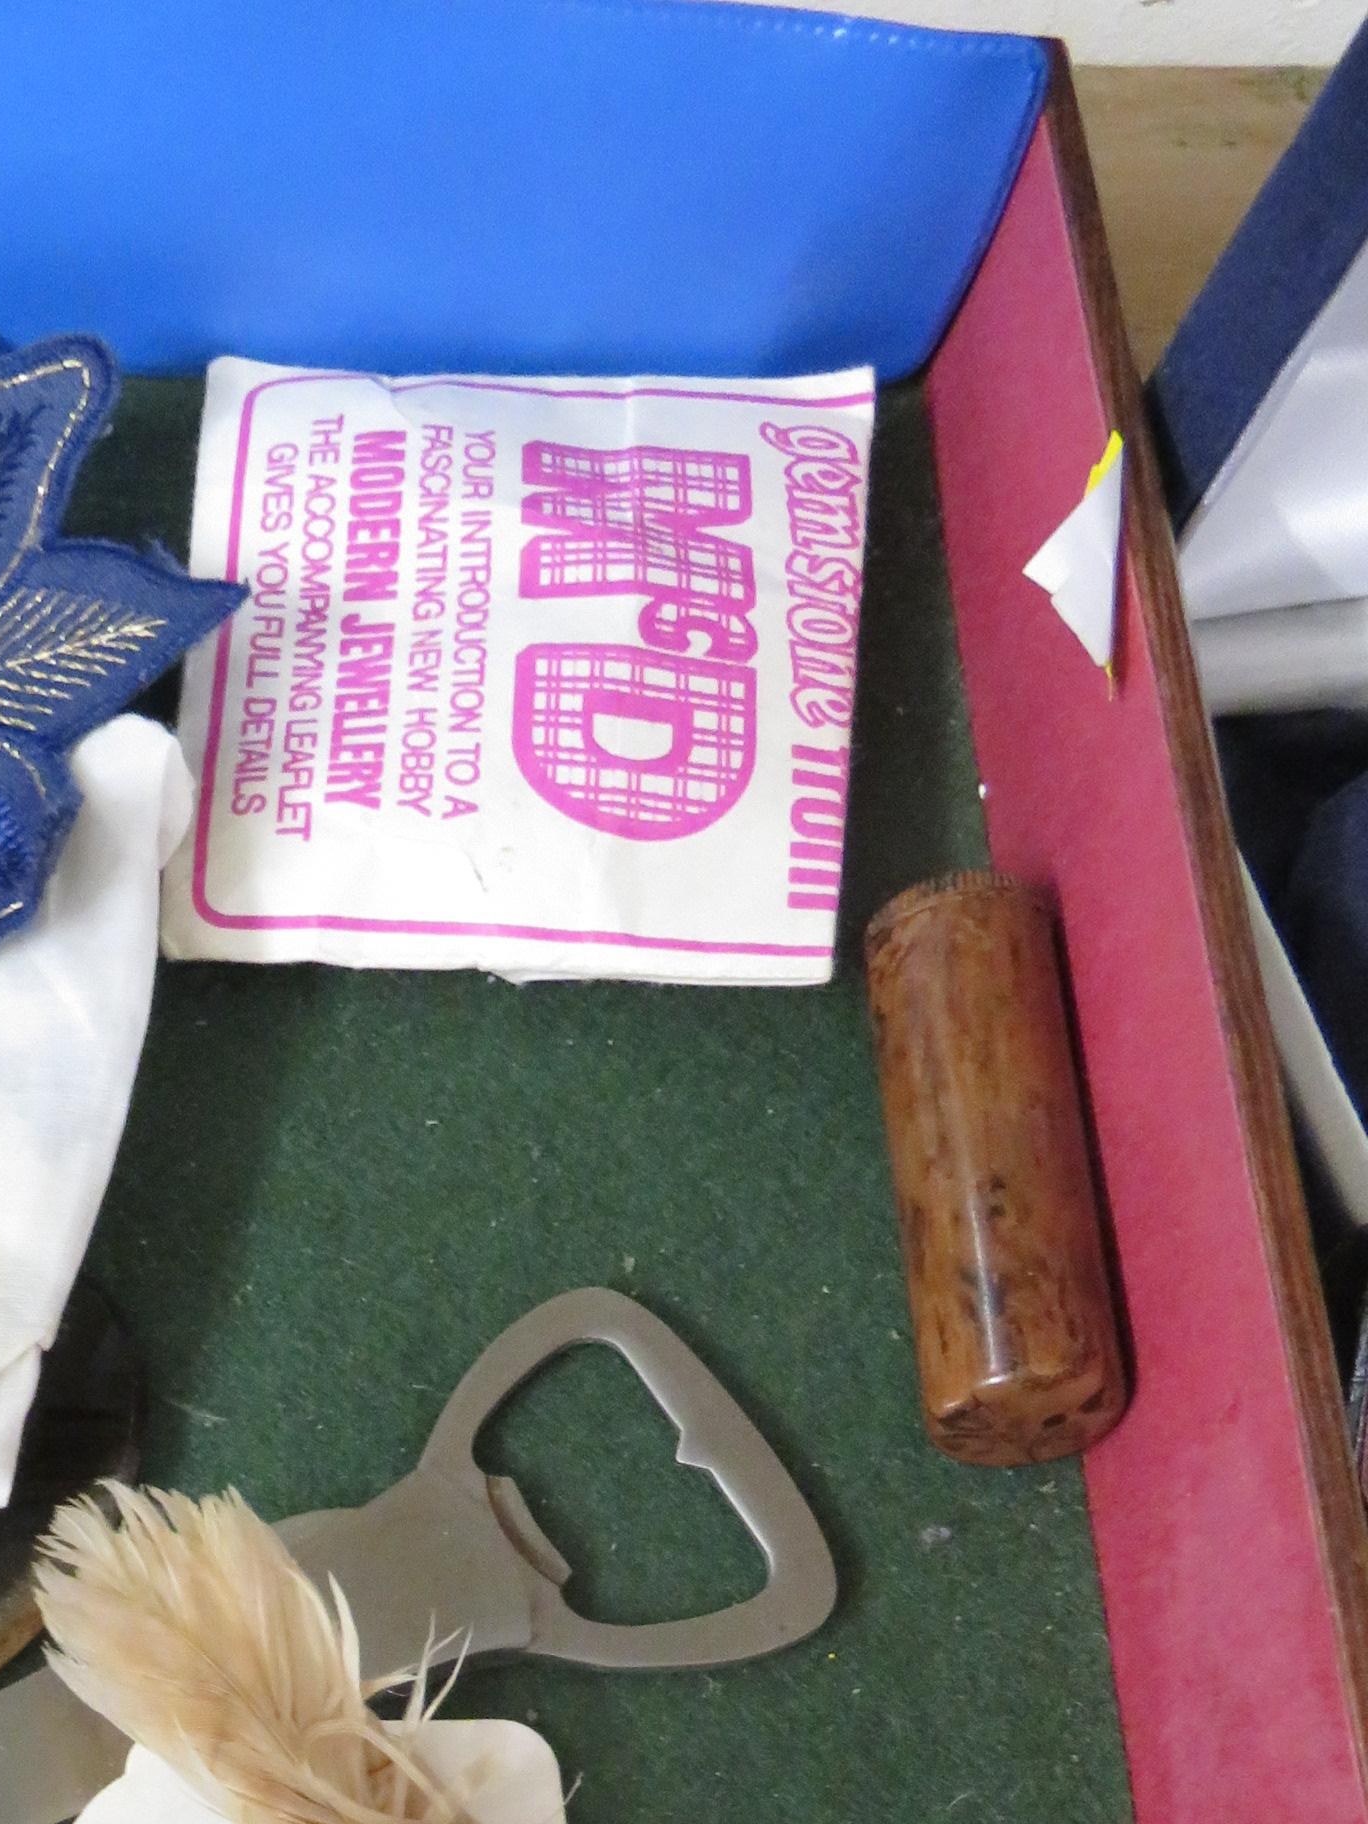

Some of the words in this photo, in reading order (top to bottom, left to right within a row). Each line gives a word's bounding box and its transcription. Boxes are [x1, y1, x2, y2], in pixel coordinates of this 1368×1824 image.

[263, 444, 294, 531] GIVES
[309, 415, 343, 463] THE
[463, 431, 495, 498] YOUR
[344, 432, 405, 601] MODERN
[414, 426, 453, 620] FASCINATING
[254, 544, 288, 608] YOU
[290, 475, 334, 712] ACCOMPANYING
[450, 511, 490, 732] INTRODUCTION
[761, 422, 860, 729] gemstone
[247, 617, 283, 688] FULL
[410, 632, 440, 690] NEW
[232, 698, 276, 813] DETAILS
[326, 614, 394, 808] JEWELLERY
[400, 710, 434, 815] HOBBY
[277, 719, 318, 840] LEAFLET
[443, 797, 475, 820] A
[447, 743, 481, 785] TO
